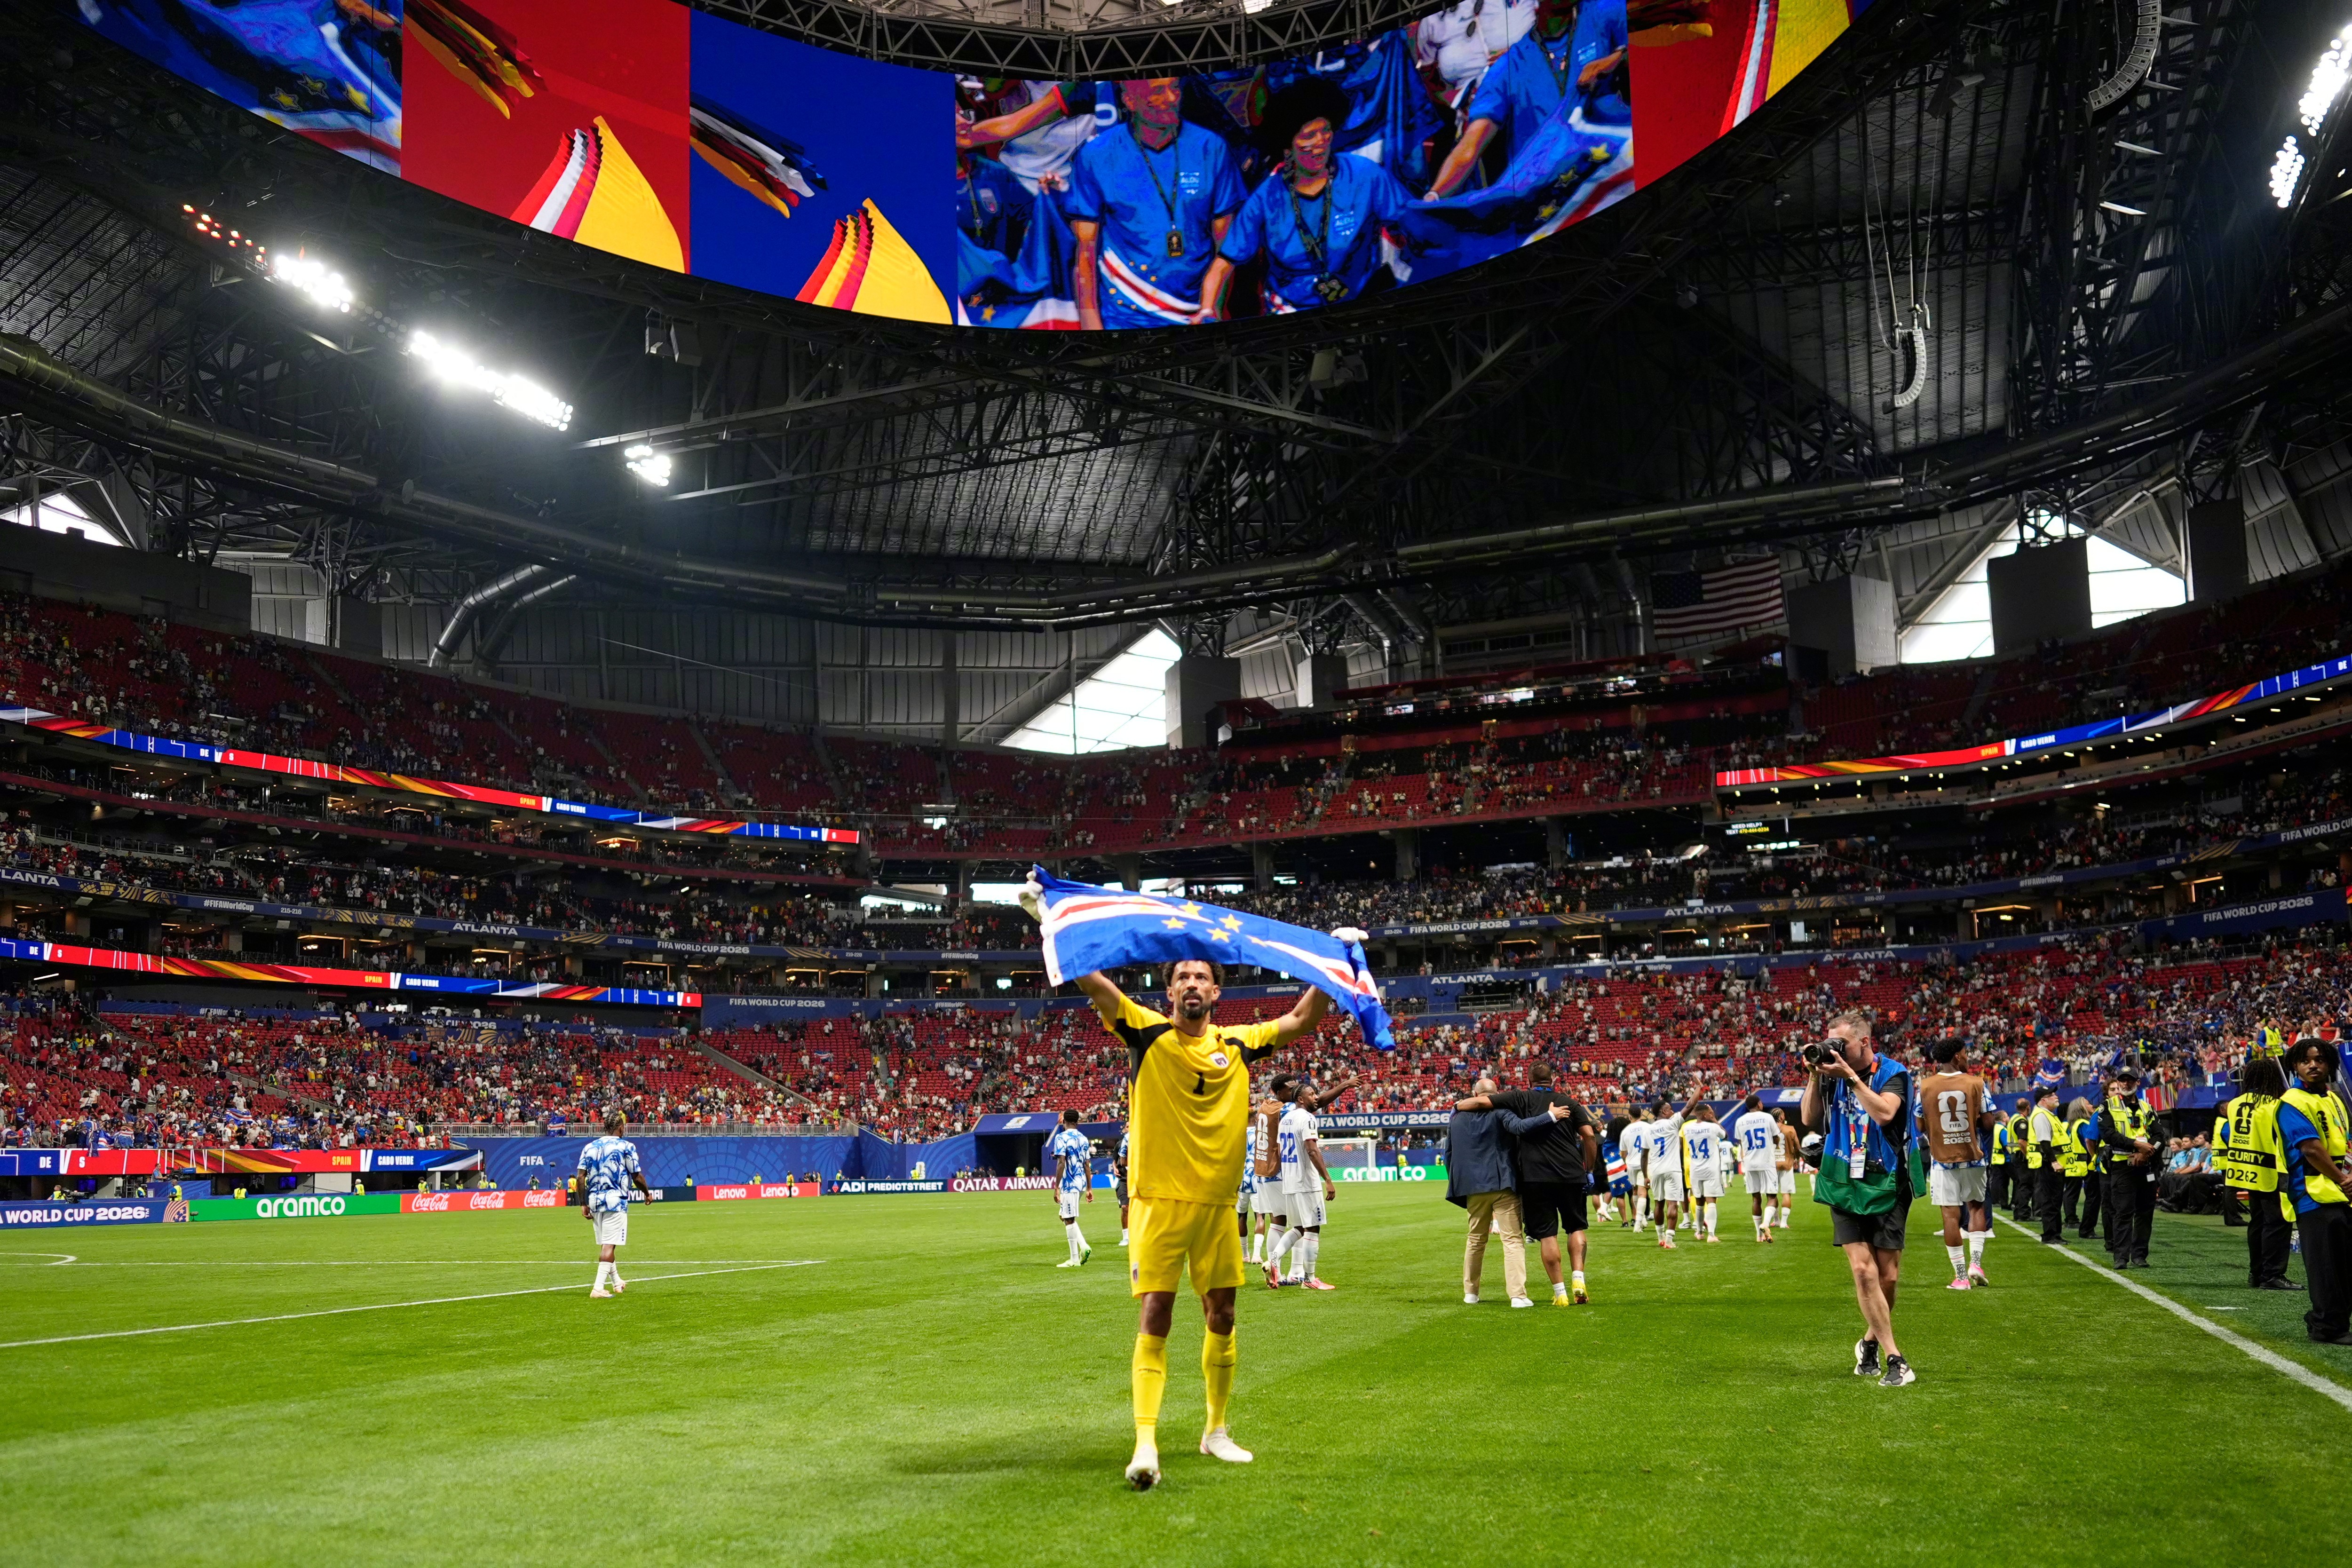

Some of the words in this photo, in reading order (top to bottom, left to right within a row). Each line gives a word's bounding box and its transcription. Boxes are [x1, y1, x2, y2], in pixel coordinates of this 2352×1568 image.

[2338, 660, 2347, 670] DE
[1980, 746, 1998, 757] SPAIN
[2020, 739, 2036, 749] CABO
[2037, 735, 2056, 745] VERDE
[200, 748, 209, 757] DE
[229, 752, 234, 761] S
[520, 797, 536, 806] SPAIN
[556, 803, 570, 812] CABO
[570, 805, 586, 814] VERDE
[2281, 829, 2302, 842] FIFA
[2304, 822, 2340, 837] WORLD
[2341, 818, 2352, 828] CU
[0, 869, 60, 887] LANTA
[2019, 875, 2063, 887] #FIFAWorldCup
[204, 899, 254, 912] #FIFAWorldCup
[1664, 904, 1734, 917] ATLANTA
[2203, 910, 2223, 922] FIFA
[2224, 905, 2257, 919] WORLD
[2258, 902, 2278, 913] CUP
[2279, 895, 2313, 910] 2026
[452, 922, 518, 935] ATLANTA
[1429, 924, 1459, 932] WORLD
[1480, 920, 1510, 929] 2026
[29, 946, 38, 955] DE
[57, 949, 62, 958] S
[657, 941, 673, 950] FIFA
[674, 942, 701, 952] WORLD
[703, 945, 719, 953] CUP
[720, 946, 749, 954] 2026
[364, 975, 382, 983] SPAIN
[405, 978, 421, 987] CABO
[421, 979, 439, 988] VERDE
[1431, 974, 1495, 984] ATLANTA
[747, 998, 778, 1007] WORLD
[779, 999, 796, 1007] CUP
[463, 1021, 497, 1029] 026
[1193, 1072, 1205, 1095] 1
[1317, 1117, 1335, 1127] IFA
[1336, 1116, 1380, 1126] WORLD
[1382, 1115, 1407, 1125] CUP
[1408, 1113, 1449, 1124] 2026
[1634, 1135, 1642, 1153] 4
[1745, 1128, 1766, 1151] 15
[1943, 1136, 1972, 1145] 2026
[1279, 1132, 1298, 1163] 22
[1654, 1137, 1665, 1157] 7
[1688, 1138, 1710, 1159] 14
[40, 1156, 52, 1169] DE
[79, 1156, 86, 1168] S
[332, 1156, 352, 1165] SPAIN
[378, 1156, 394, 1165] CABO
[395, 1156, 414, 1165] VERDE
[520, 1156, 544, 1166] FIFA
[2227, 1150, 2265, 1164] CURITY
[1343, 1166, 1426, 1181] aramco
[2227, 1168, 2257, 1184] 0262
[761, 1185, 799, 1197] Lenovo
[840, 1182, 865, 1193] ADI
[867, 1182, 943, 1192] PREDICTSTREET
[953, 1178, 999, 1193] QATAR
[1004, 1176, 1057, 1190] AIRWAYS
[524, 1190, 559, 1207] Coca-Cola
[713, 1186, 746, 1199] Lenovo
[256, 1196, 345, 1218] aramco
[412, 1193, 450, 1212] Coca-Cola
[470, 1191, 506, 1210] Coca-Cola
[6, 1209, 62, 1224] WORLD
[64, 1208, 94, 1222] CUP
[96, 1206, 145, 1221] 2026
